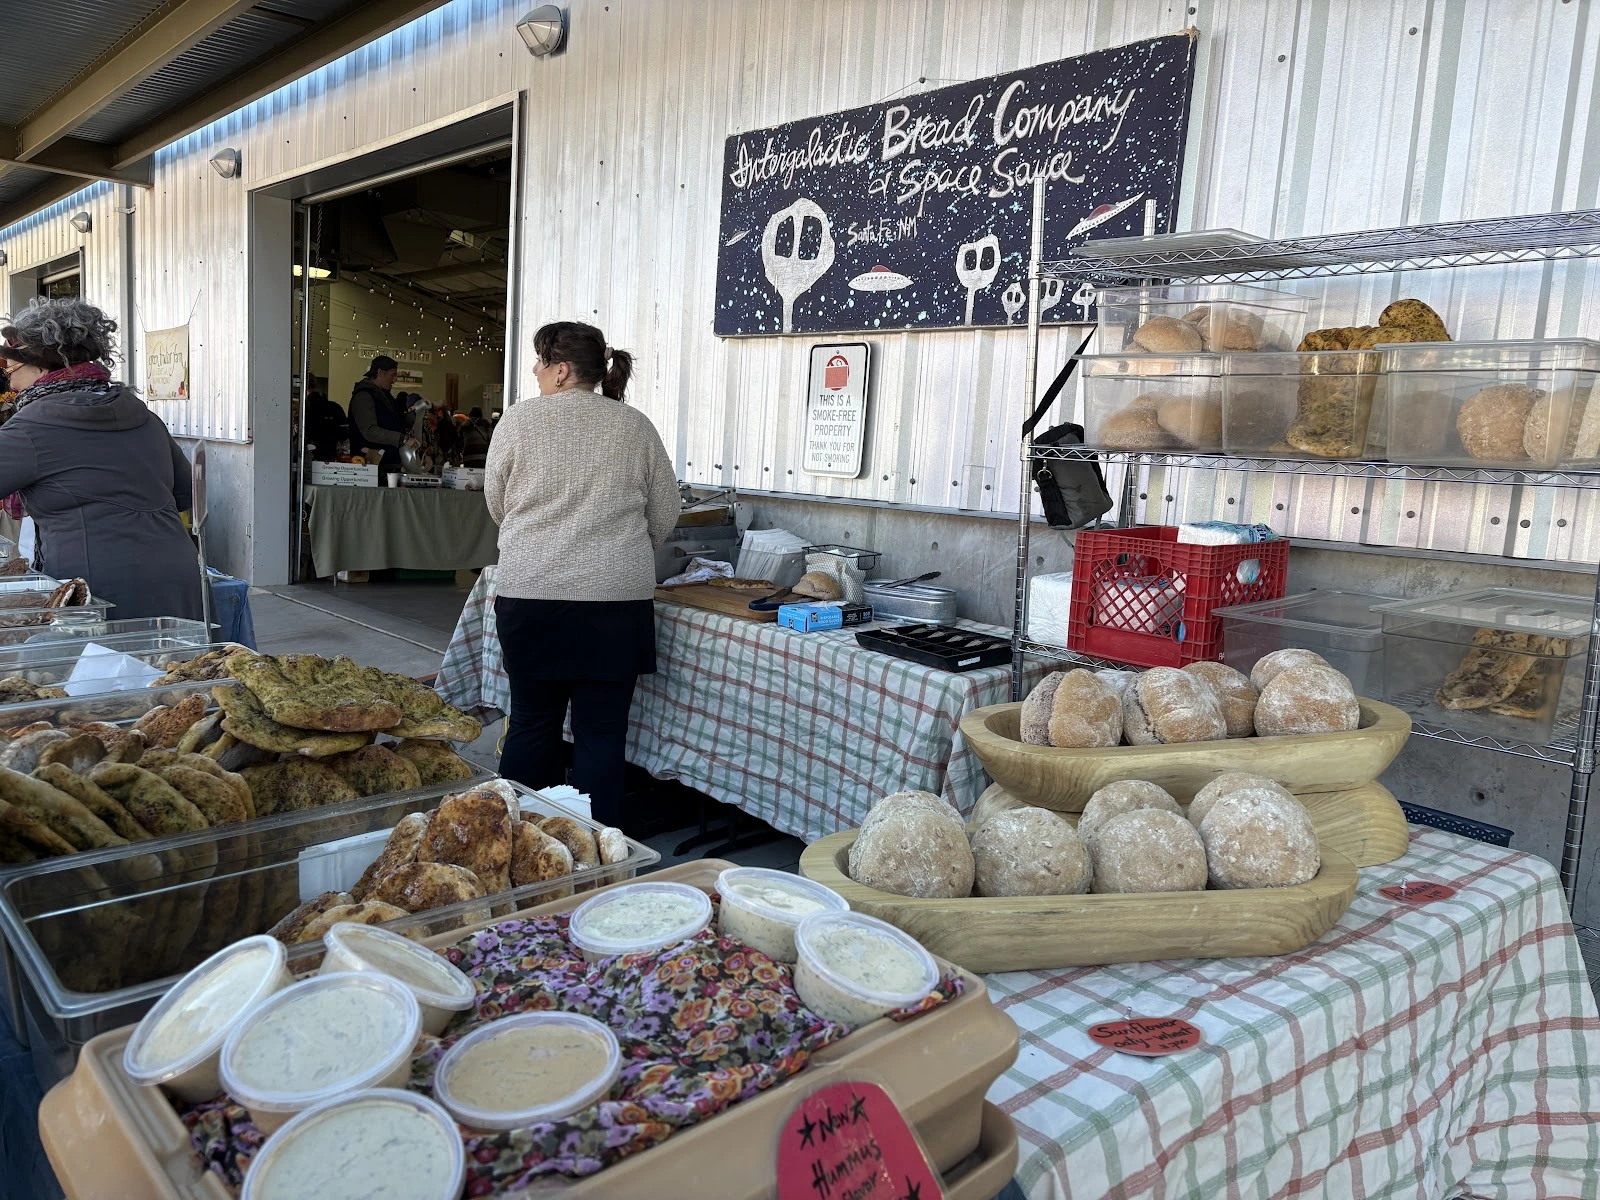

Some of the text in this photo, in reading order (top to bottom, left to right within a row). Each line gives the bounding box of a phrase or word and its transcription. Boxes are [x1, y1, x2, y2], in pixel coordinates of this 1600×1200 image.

[730, 79, 1137, 190] Intergalactic Bread Company
[897, 158, 983, 218] Space
[988, 147, 1086, 199] Sauce
[847, 218, 876, 244] Santa
[819, 394, 851, 406] THIS IS A
[812, 410, 857, 422] SMOKE-FREE
[814, 424, 852, 436] PROPERTY
[809, 441, 855, 452] THANK YOU FOR
[811, 453, 850, 463] NOT SMOKING
[1093, 1019, 1178, 1038] Sunflower
